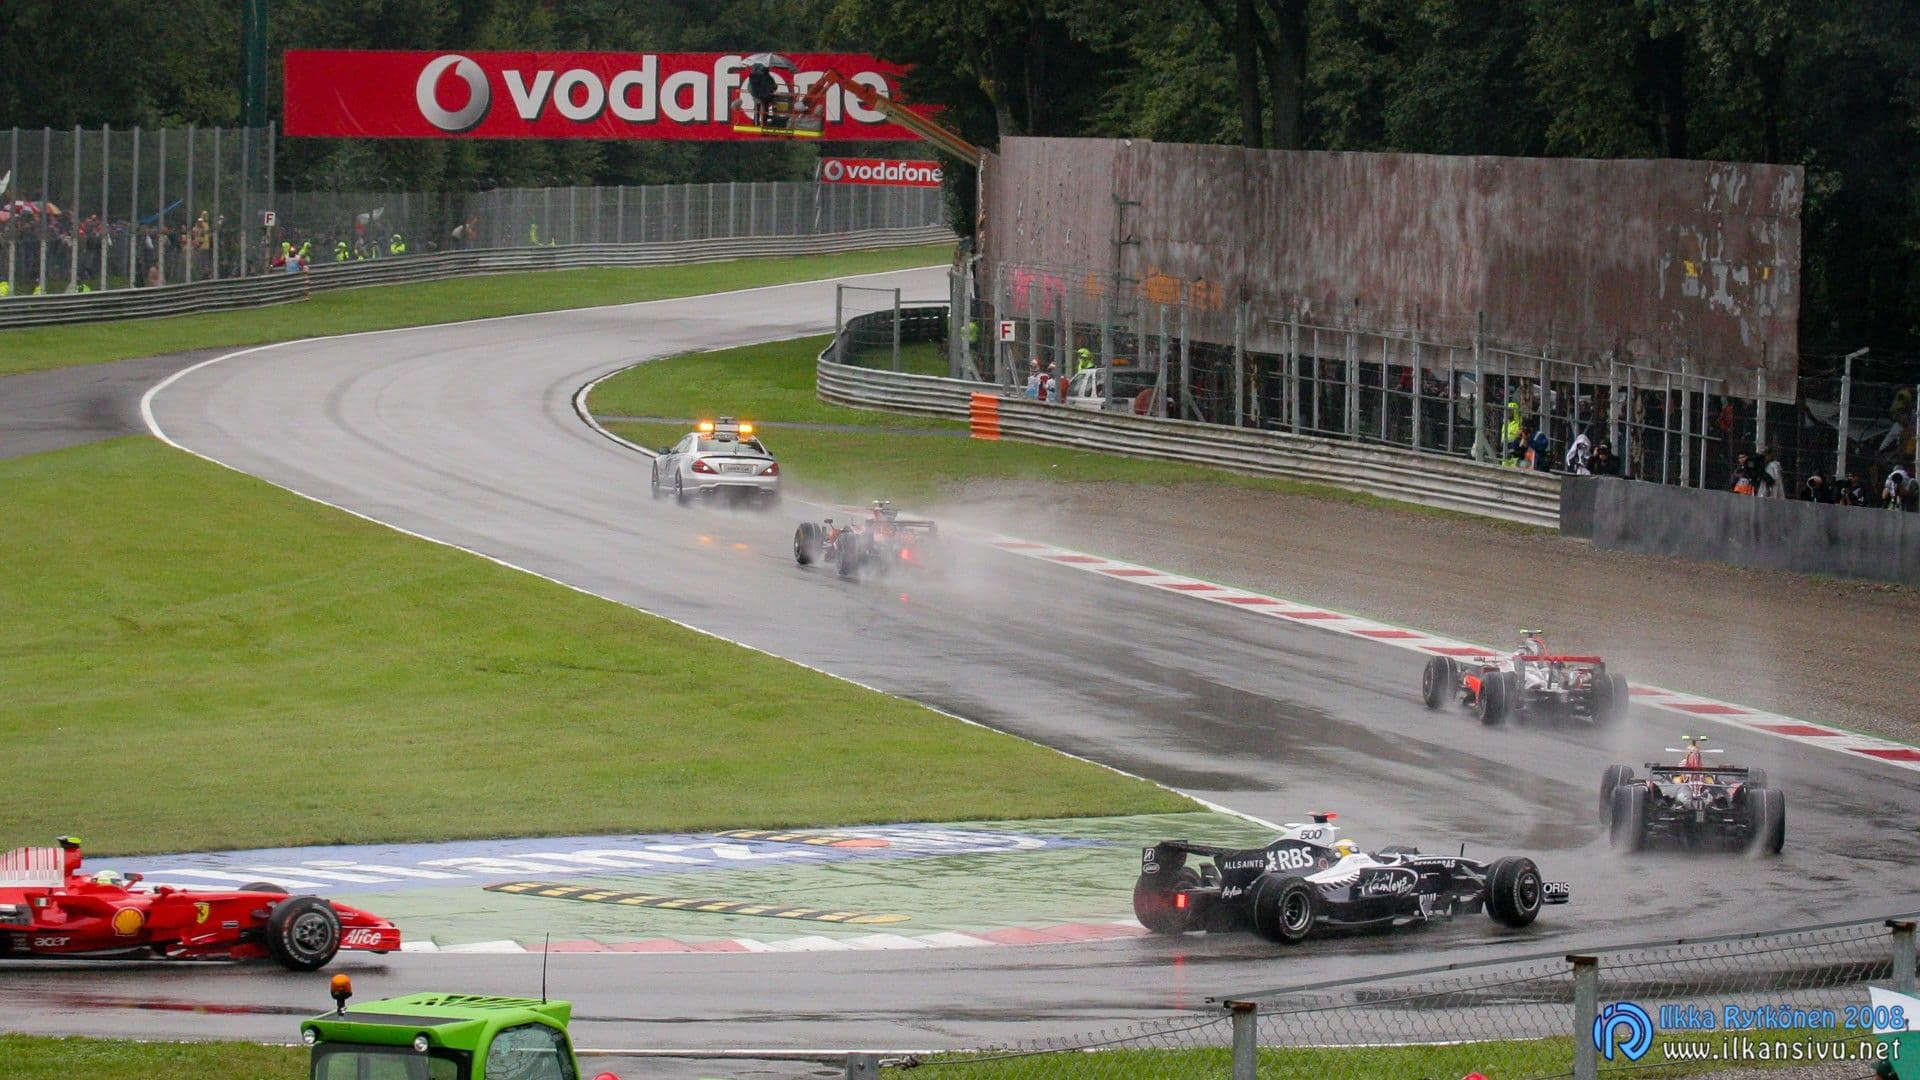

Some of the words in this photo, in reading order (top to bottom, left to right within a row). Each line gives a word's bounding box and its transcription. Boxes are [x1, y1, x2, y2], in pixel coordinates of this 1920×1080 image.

[846, 162, 944, 182] vodafone
[265, 213, 273, 226] F
[1001, 323, 1012, 340] F
[1224, 859, 1264, 869] ALLSAINTS
[1279, 846, 1314, 869] RBS
[1543, 882, 1570, 894] ORIS
[34, 936, 70, 947] acer
[344, 928, 381, 945] Alice
